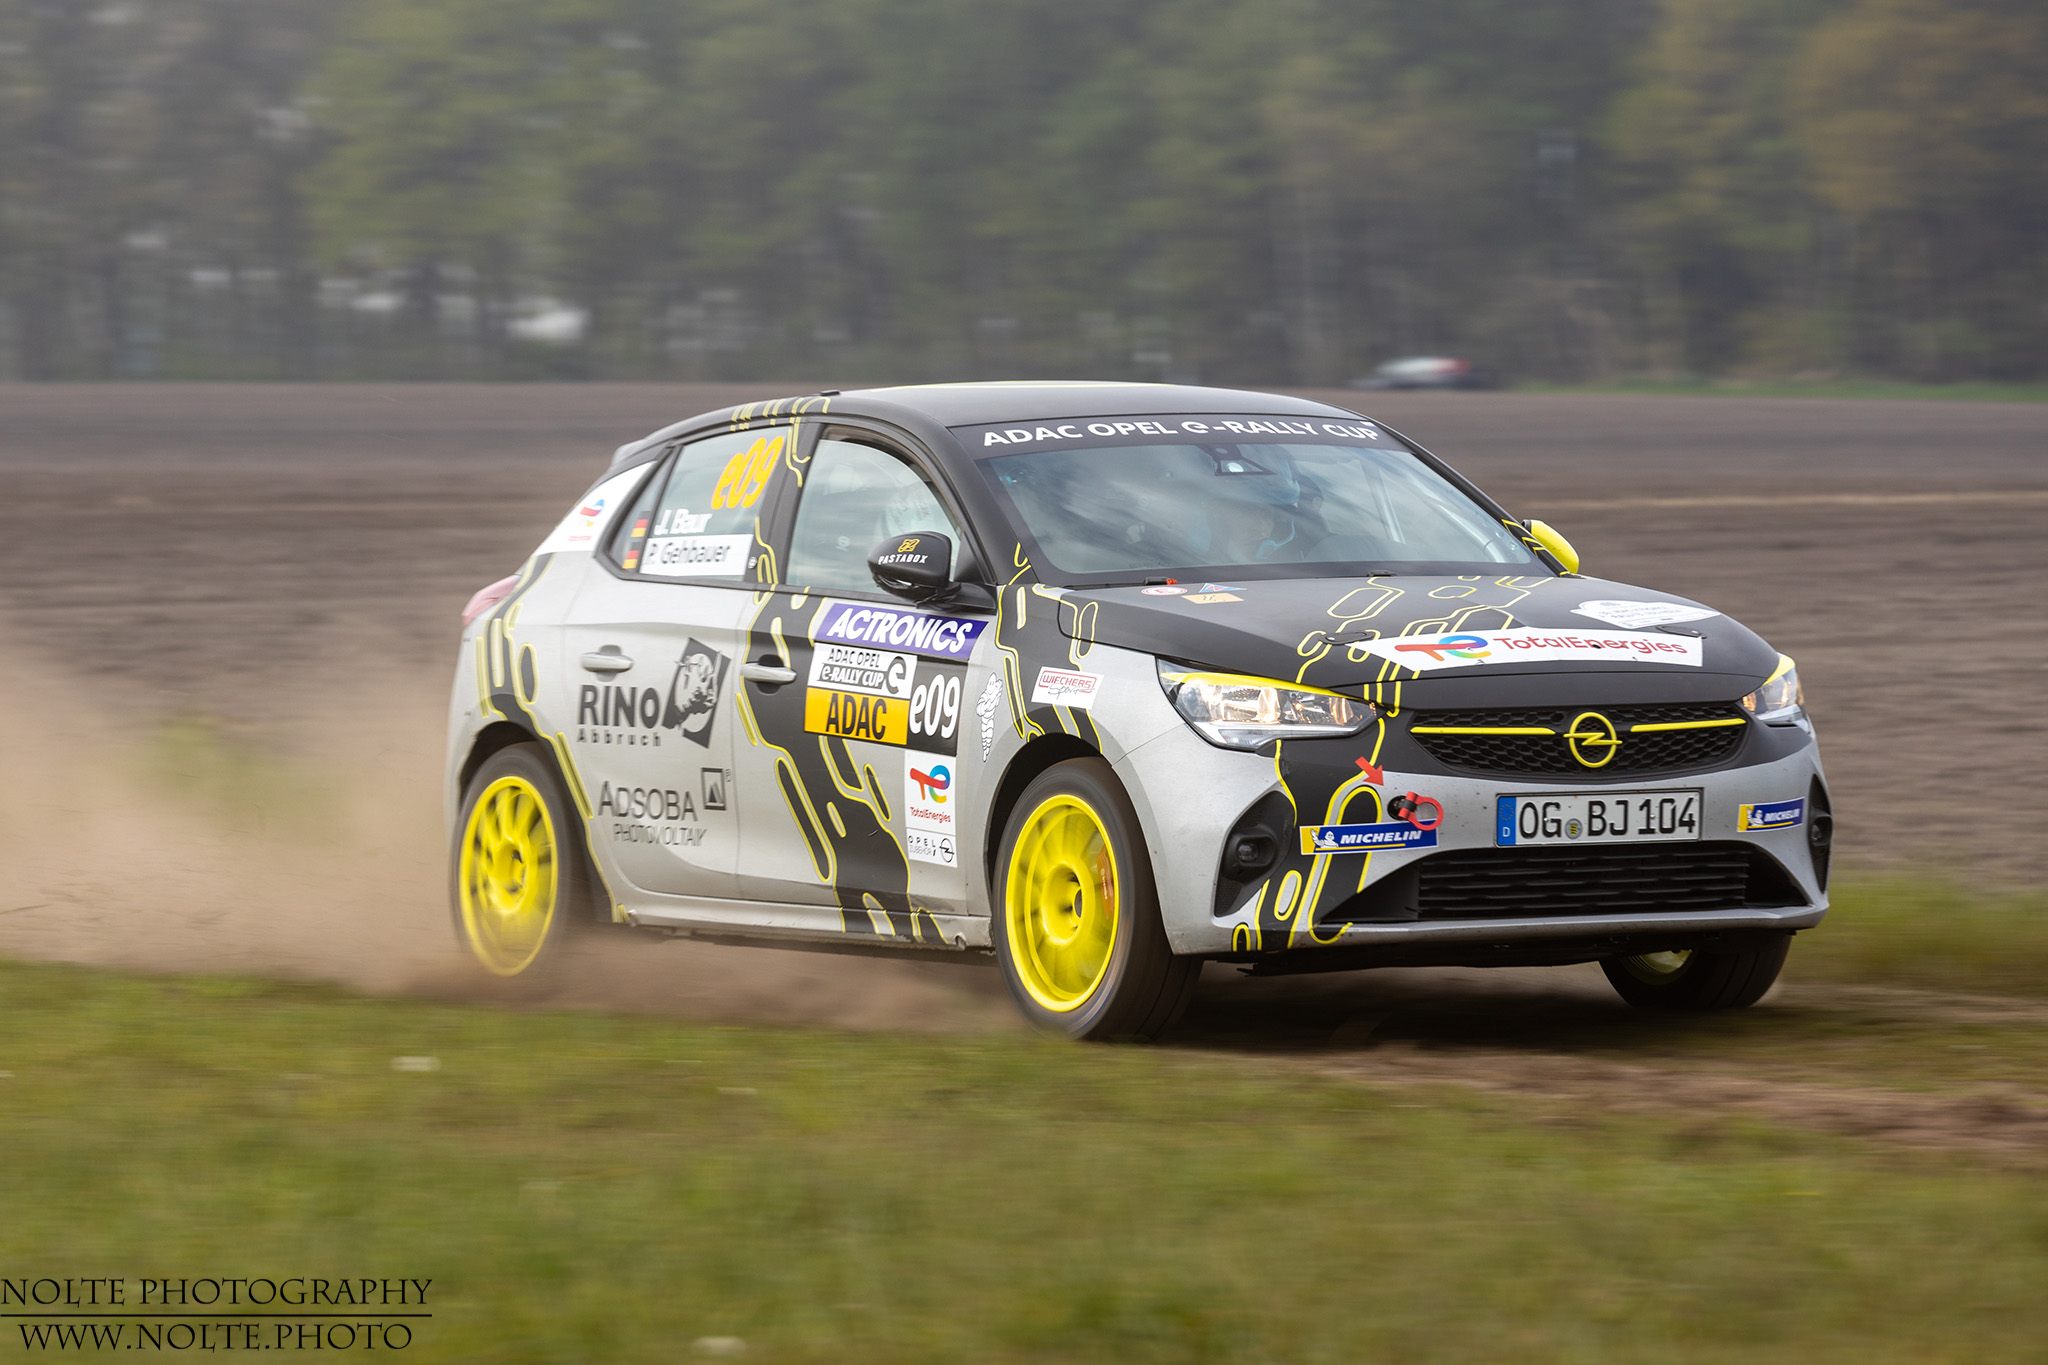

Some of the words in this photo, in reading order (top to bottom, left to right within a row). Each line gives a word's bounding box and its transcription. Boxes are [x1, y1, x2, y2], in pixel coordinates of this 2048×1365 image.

[984, 424, 1083, 446] ADAC
[1091, 421, 1177, 437] OPEL
[1322, 424, 1379, 441] CUP
[710, 435, 784, 510] e09
[670, 508, 713, 534] Baur
[661, 539, 732, 565] Gehbauer
[877, 553, 929, 565] PASTABOX
[827, 608, 973, 653] ACTRONICS
[829, 648, 856, 665] ADAC
[857, 653, 880, 667] OPEL
[1493, 636, 1688, 654] TotalEnergies
[863, 671, 885, 687] CUP
[578, 684, 661, 729] RINO
[825, 692, 888, 740] ADAC
[909, 674, 961, 739] e09
[576, 728, 662, 747] Abbruch
[597, 780, 699, 822] ADSOBA
[909, 806, 951, 824] TotalEnergies
[1518, 801, 1562, 839] OG
[1587, 799, 1629, 837] BJ
[1638, 797, 1696, 835] 104
[908, 835, 936, 848] OPEL
[1340, 830, 1422, 844] MICHELIN
[1502, 827, 1511, 837] D
